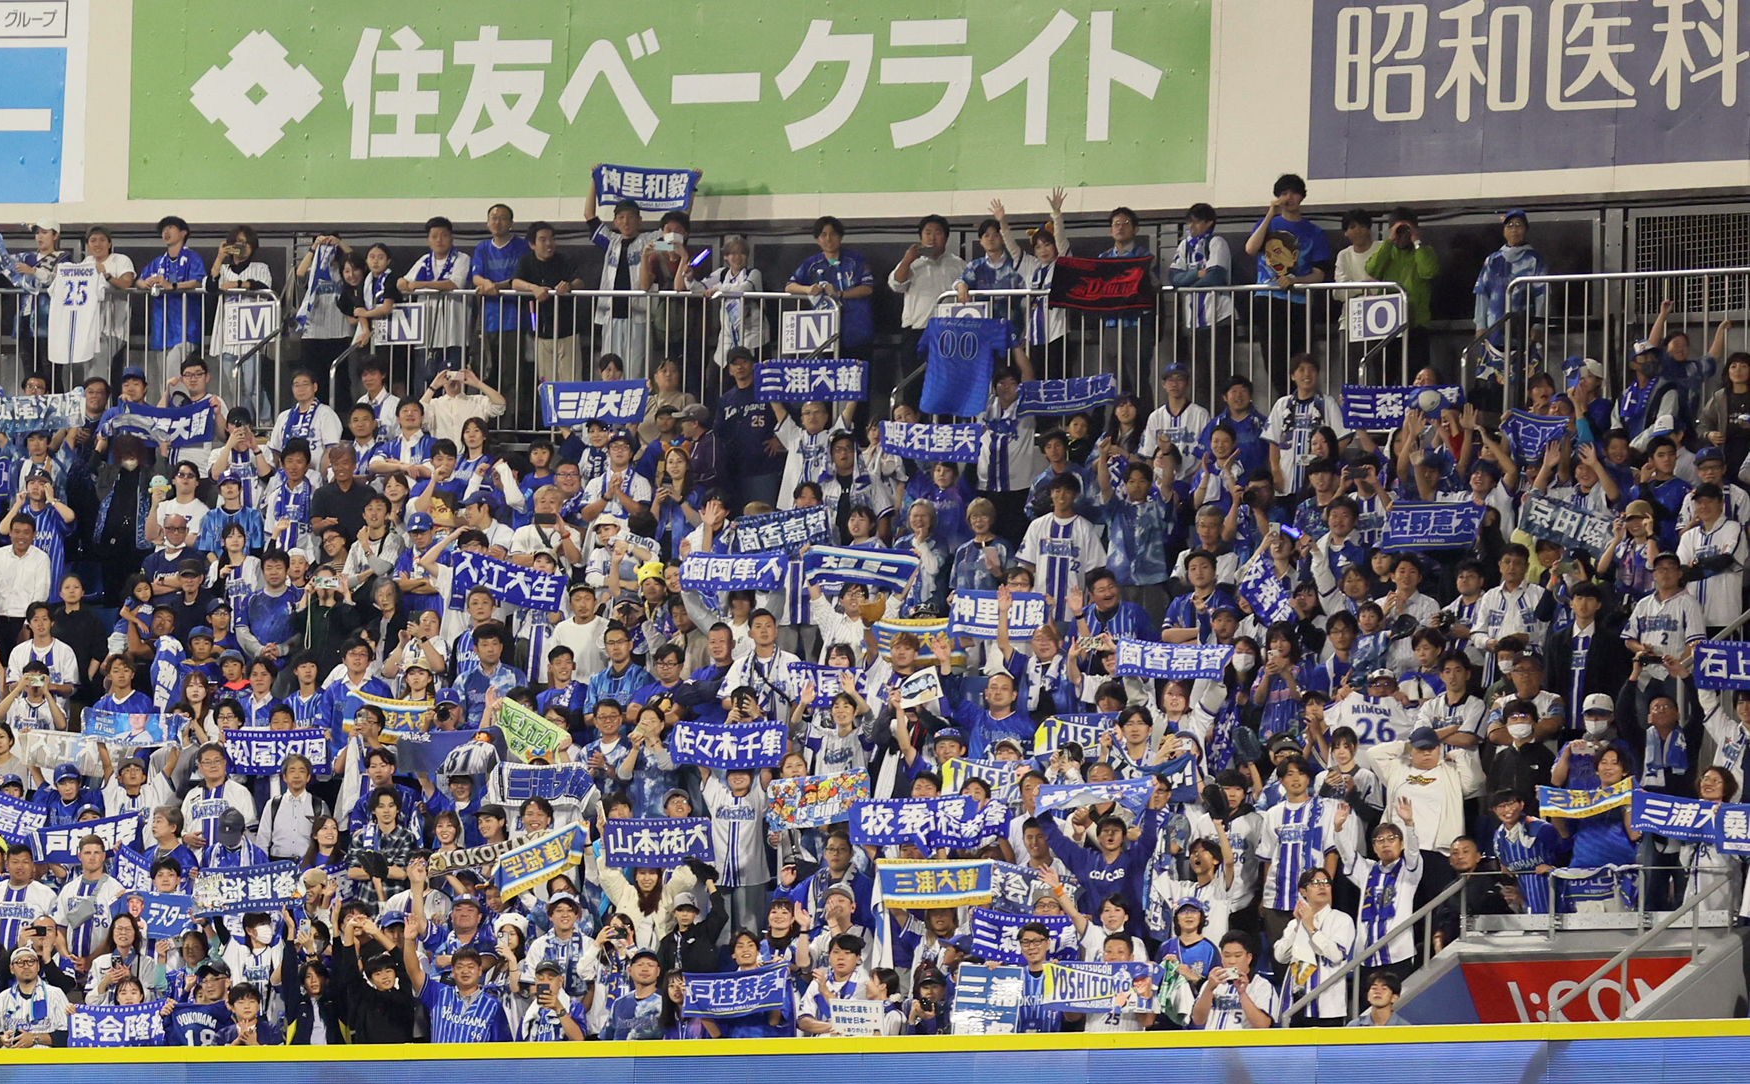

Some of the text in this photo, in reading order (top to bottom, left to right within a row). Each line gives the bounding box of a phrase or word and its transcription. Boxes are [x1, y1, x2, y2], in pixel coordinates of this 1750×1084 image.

[4, 9, 58, 29] グループ
[1335, 0, 1750, 123] 昭和医科
[341, 10, 1163, 160] 住友ベークライト
[601, 167, 690, 199] 神里和毅
[63, 280, 89, 307] 25
[239, 307, 272, 339] M
[391, 309, 419, 340] N
[799, 316, 828, 348] N
[937, 330, 979, 361] 00
[760, 366, 864, 394] 三浦大輔
[557, 388, 645, 420] 三浦大輔
[884, 423, 977, 453] 蝦名達夫
[737, 512, 827, 554] 筒香嘉智
[1389, 509, 1484, 537] 佐野恵太
[1530, 497, 1612, 549] 京田陽
[454, 552, 560, 603] 入江大生
[683, 556, 783, 582] 堀岡隼人
[1120, 641, 1228, 672] 筒香嘉智
[499, 709, 559, 751] KEITA
[675, 724, 782, 761] 佐々木千隼
[1356, 717, 1396, 746] 26
[224, 739, 327, 767] 松尾汐恩
[608, 824, 709, 857] 山本祐大
[895, 869, 980, 892] 三浦大輔
[1051, 966, 1130, 1001] YOSHITOMO
[177, 1013, 217, 1027] YOKOHAMA
[1104, 1013, 1120, 1027] 25
[1233, 1012, 1243, 1024] 5
